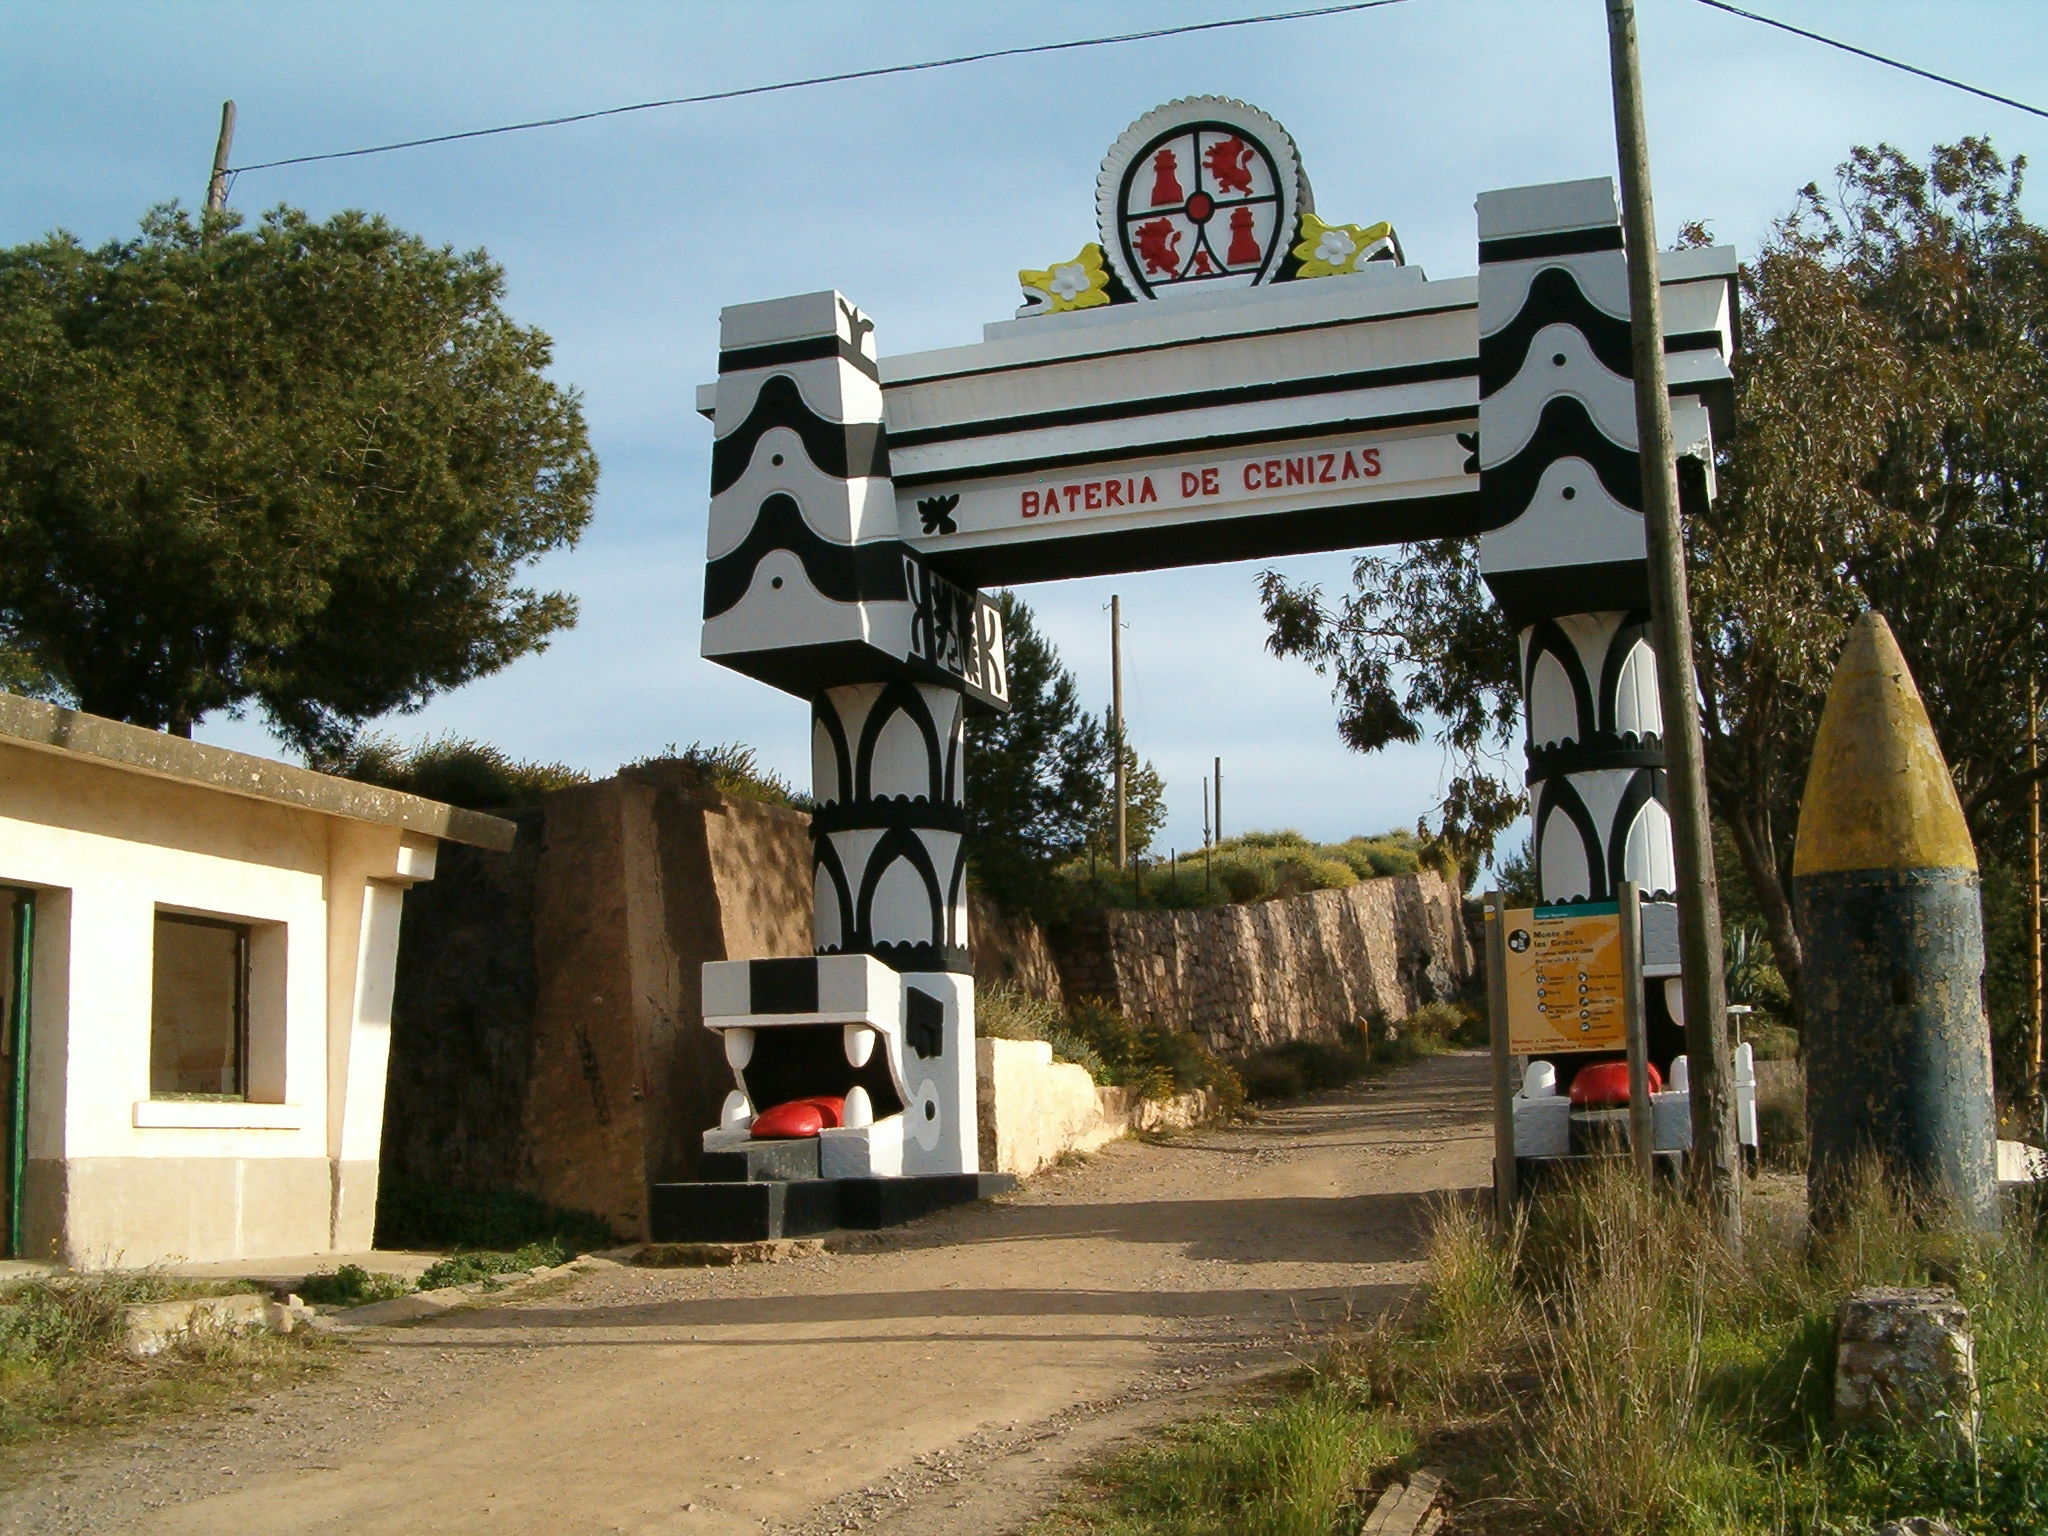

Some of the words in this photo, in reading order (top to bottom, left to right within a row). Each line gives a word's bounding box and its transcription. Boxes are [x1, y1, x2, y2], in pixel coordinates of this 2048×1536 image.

[1021, 476, 1158, 518] BATERIA
[1181, 468, 1220, 498] DE
[1244, 448, 1383, 492] CENIZAS
